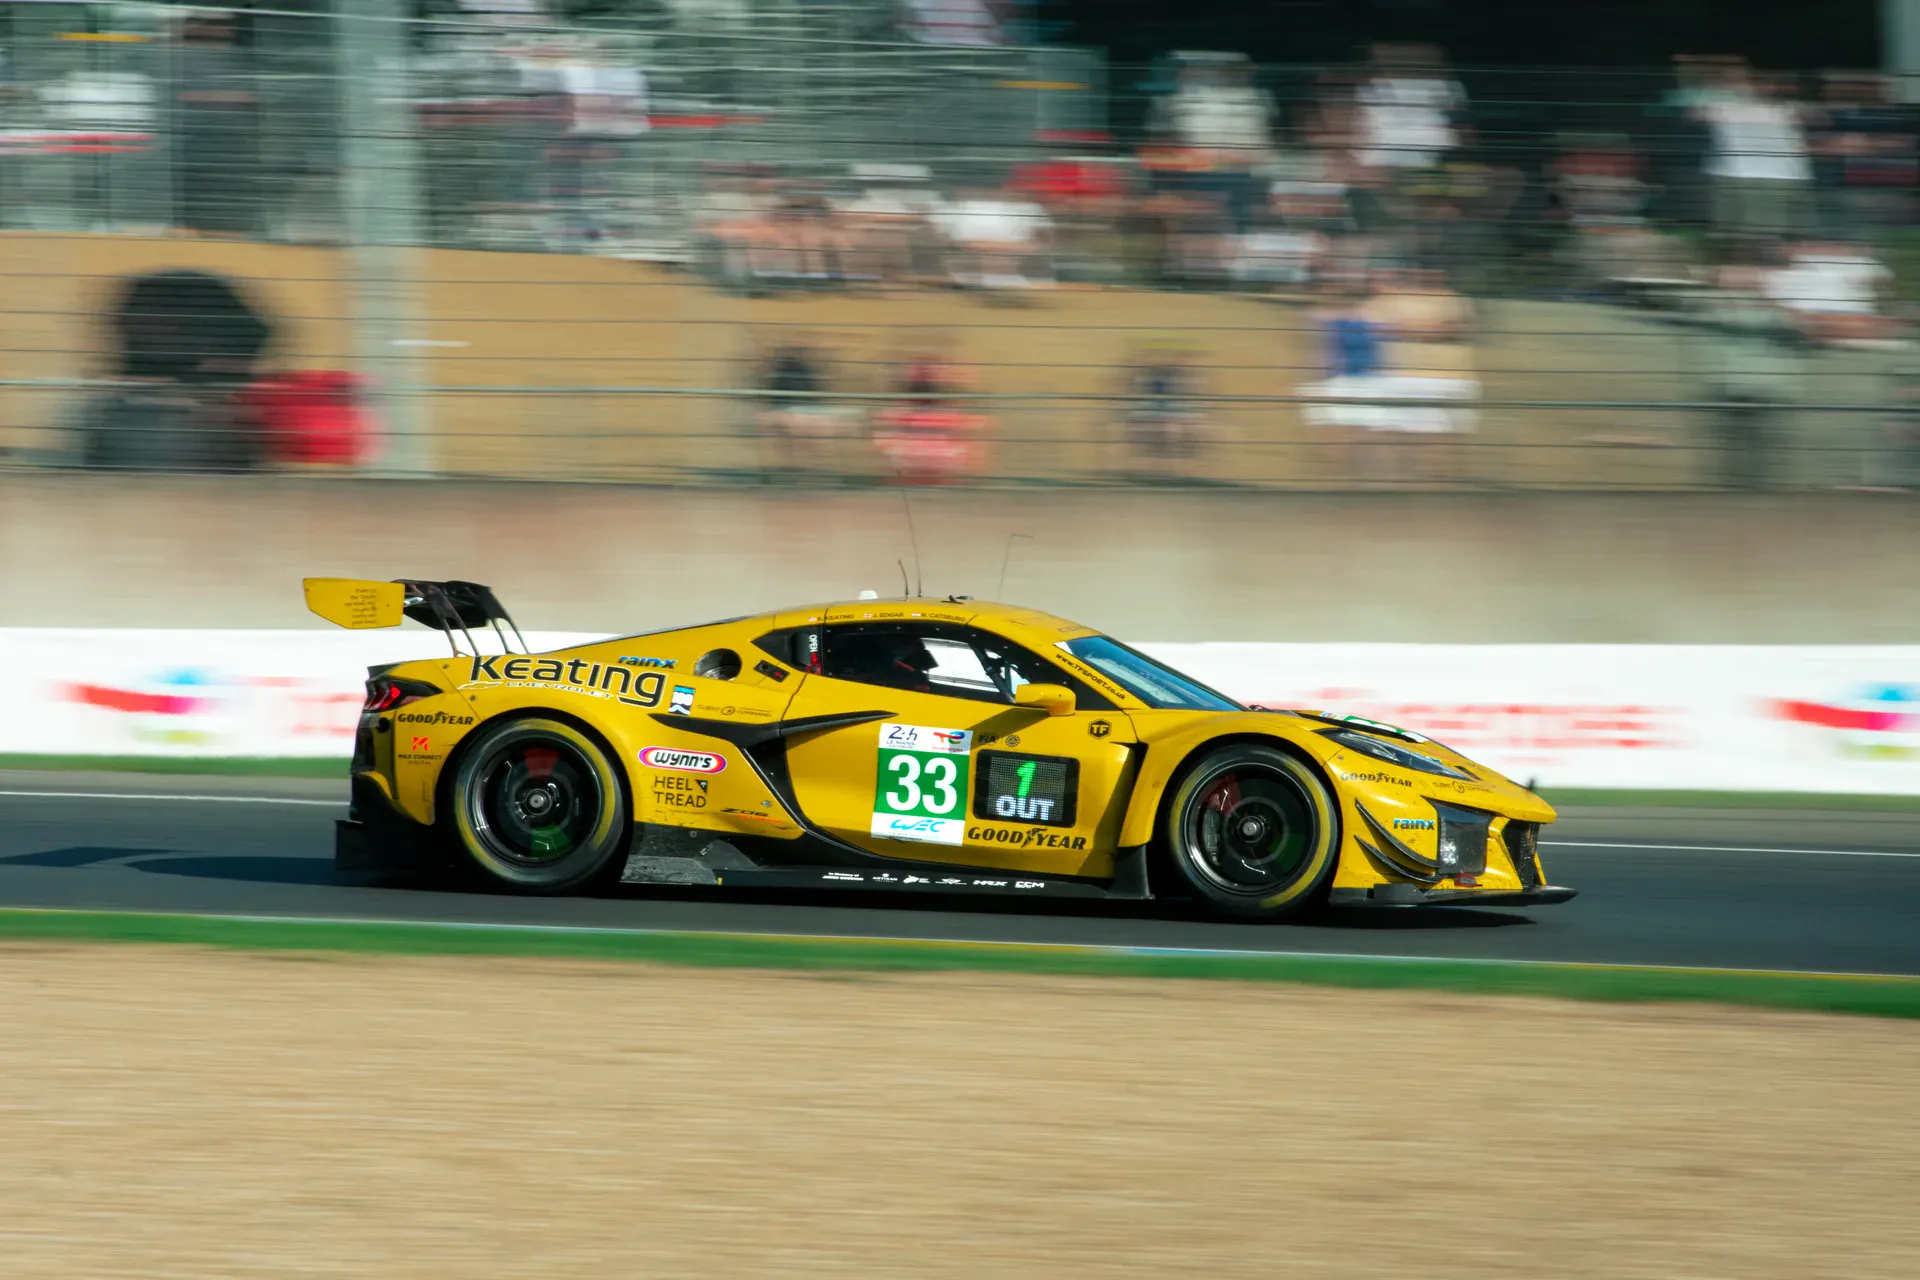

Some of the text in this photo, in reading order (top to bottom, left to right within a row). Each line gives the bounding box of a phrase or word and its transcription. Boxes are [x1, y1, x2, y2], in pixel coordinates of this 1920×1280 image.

[825, 613, 855, 621] KEATING
[929, 612, 966, 622] CATSBURG
[808, 634, 818, 652] OPEN
[470, 655, 667, 708] Keating
[1056, 653, 1126, 700] www.TFSPORT.co.uk
[506, 682, 614, 700] CHEVROLET
[1091, 724, 1109, 734] TF
[654, 776, 693, 791] HEEL
[886, 754, 957, 815] 33
[1017, 760, 1037, 797] 1
[653, 791, 707, 808] TREAD
[996, 795, 1055, 820] OUT
[889, 819, 946, 833] WEC
